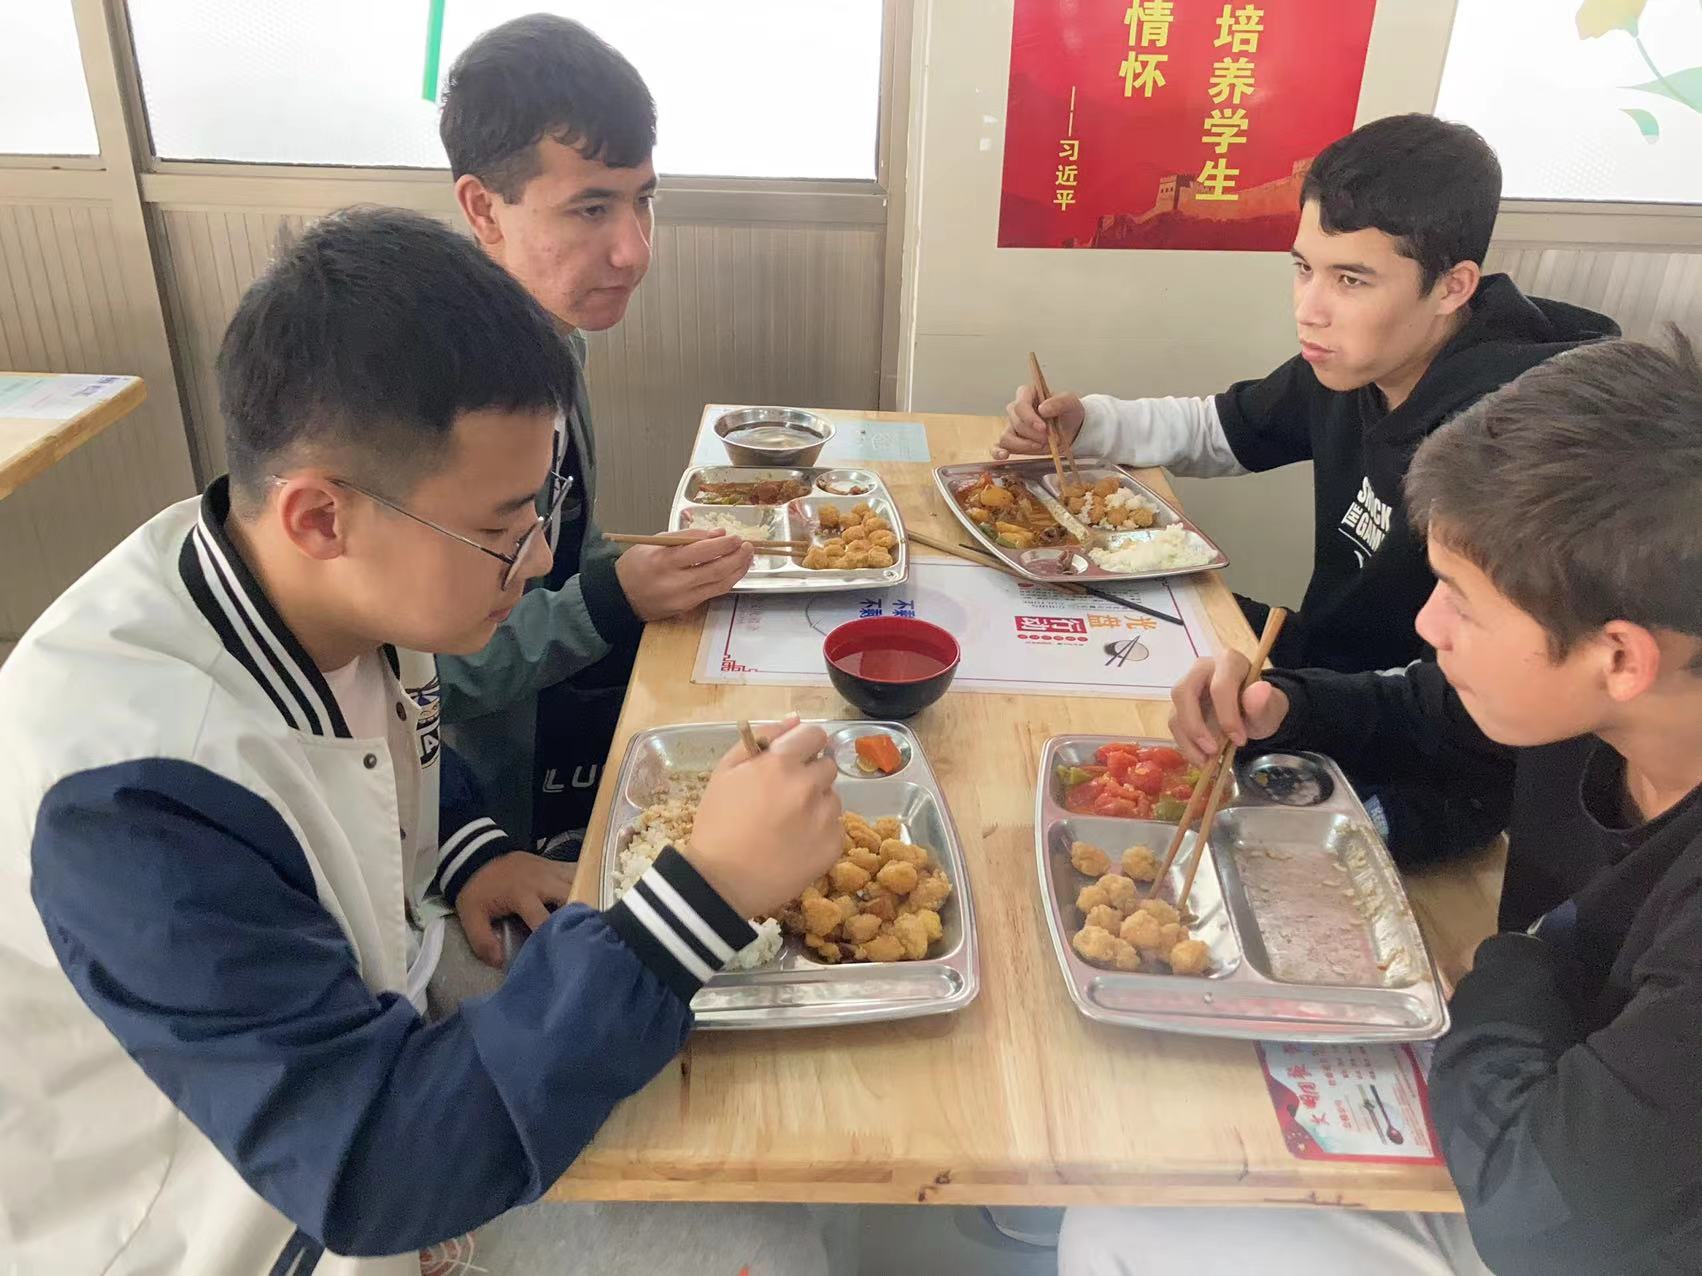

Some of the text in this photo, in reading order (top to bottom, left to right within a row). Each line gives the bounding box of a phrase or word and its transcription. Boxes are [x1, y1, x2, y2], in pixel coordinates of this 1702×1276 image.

[1118, 0, 1175, 98] 情怀
[1195, 4, 1264, 202] 培养学生
[1341, 501, 1386, 552] THE GAM
